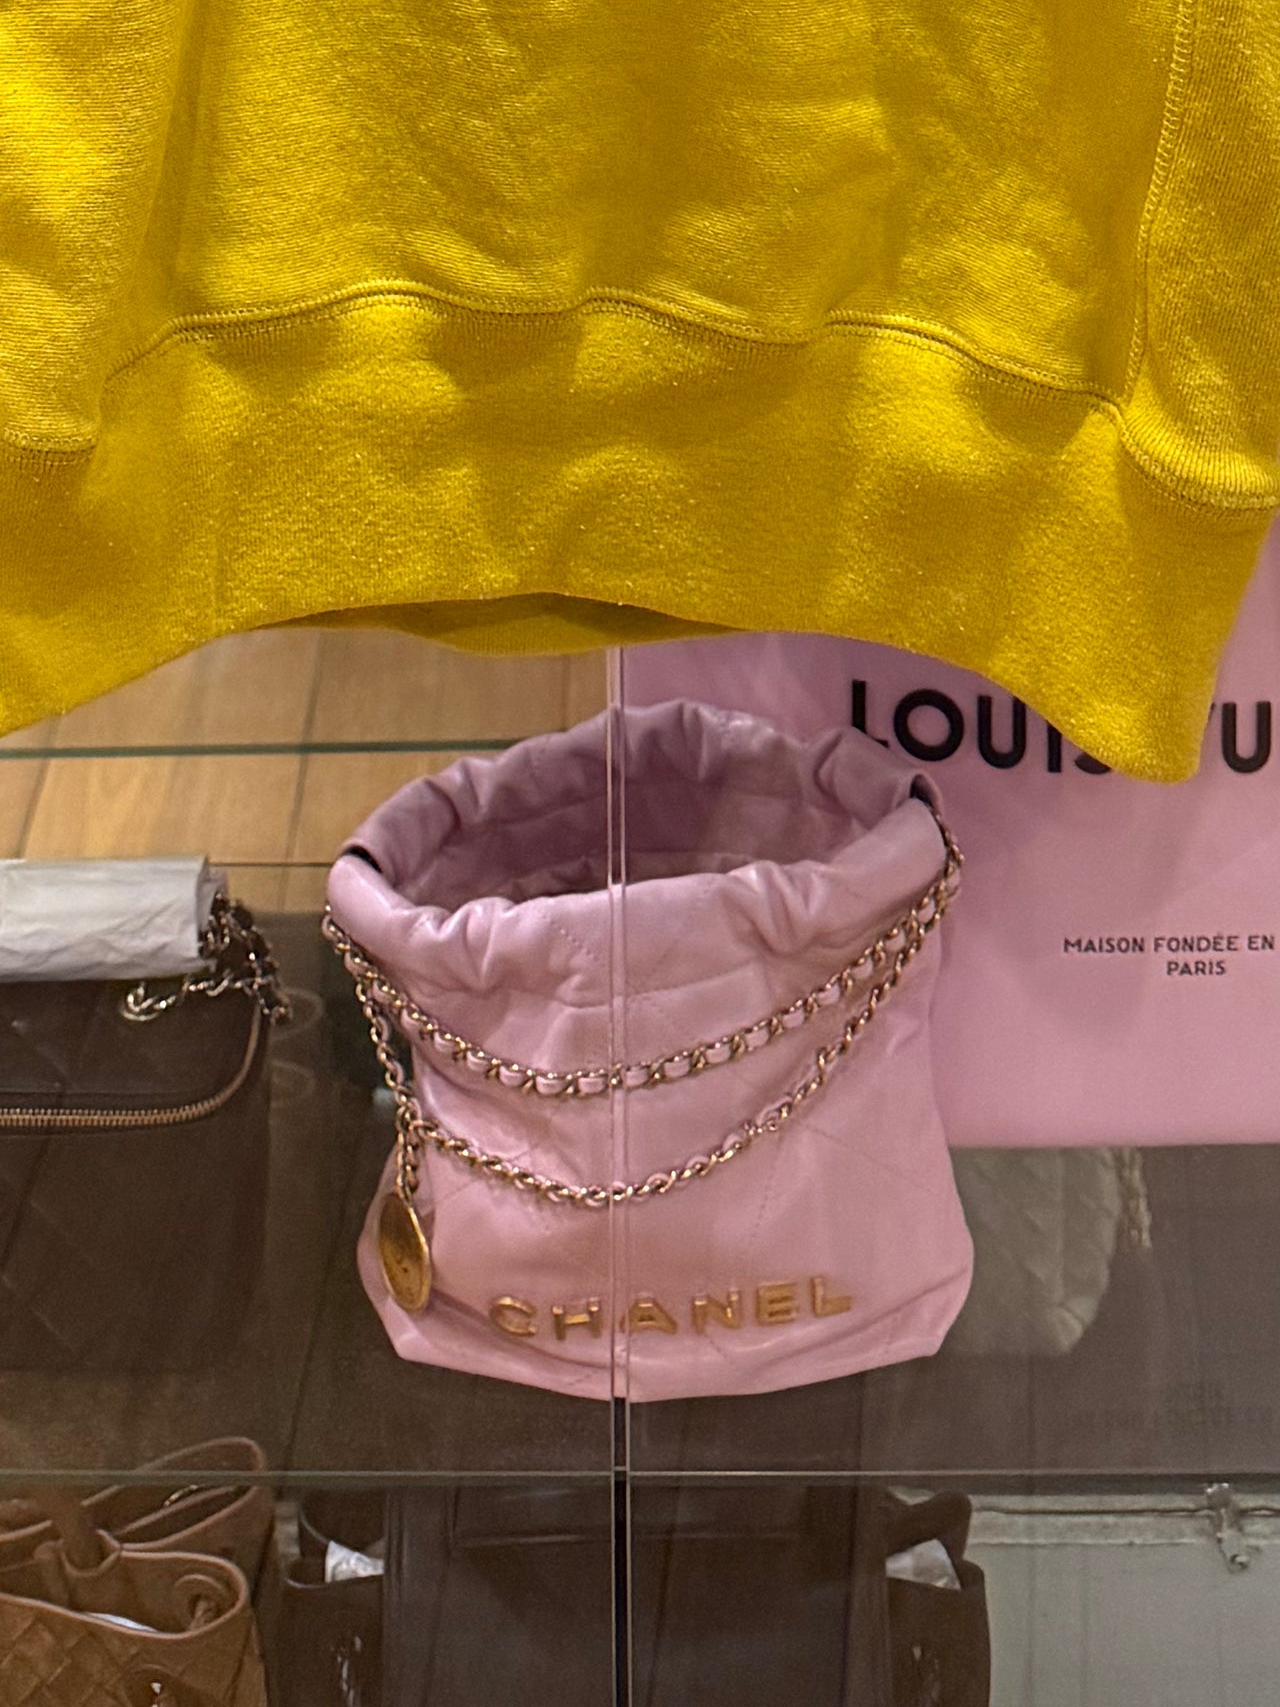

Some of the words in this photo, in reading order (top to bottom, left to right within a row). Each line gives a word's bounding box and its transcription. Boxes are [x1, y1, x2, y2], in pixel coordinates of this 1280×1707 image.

[851, 679, 1113, 775] LOUI
[1063, 937, 1145, 954] MAISON
[1248, 934, 1275, 951] EN
[1166, 960, 1227, 976] PARIS
[492, 1275, 853, 1341] CHANEL
